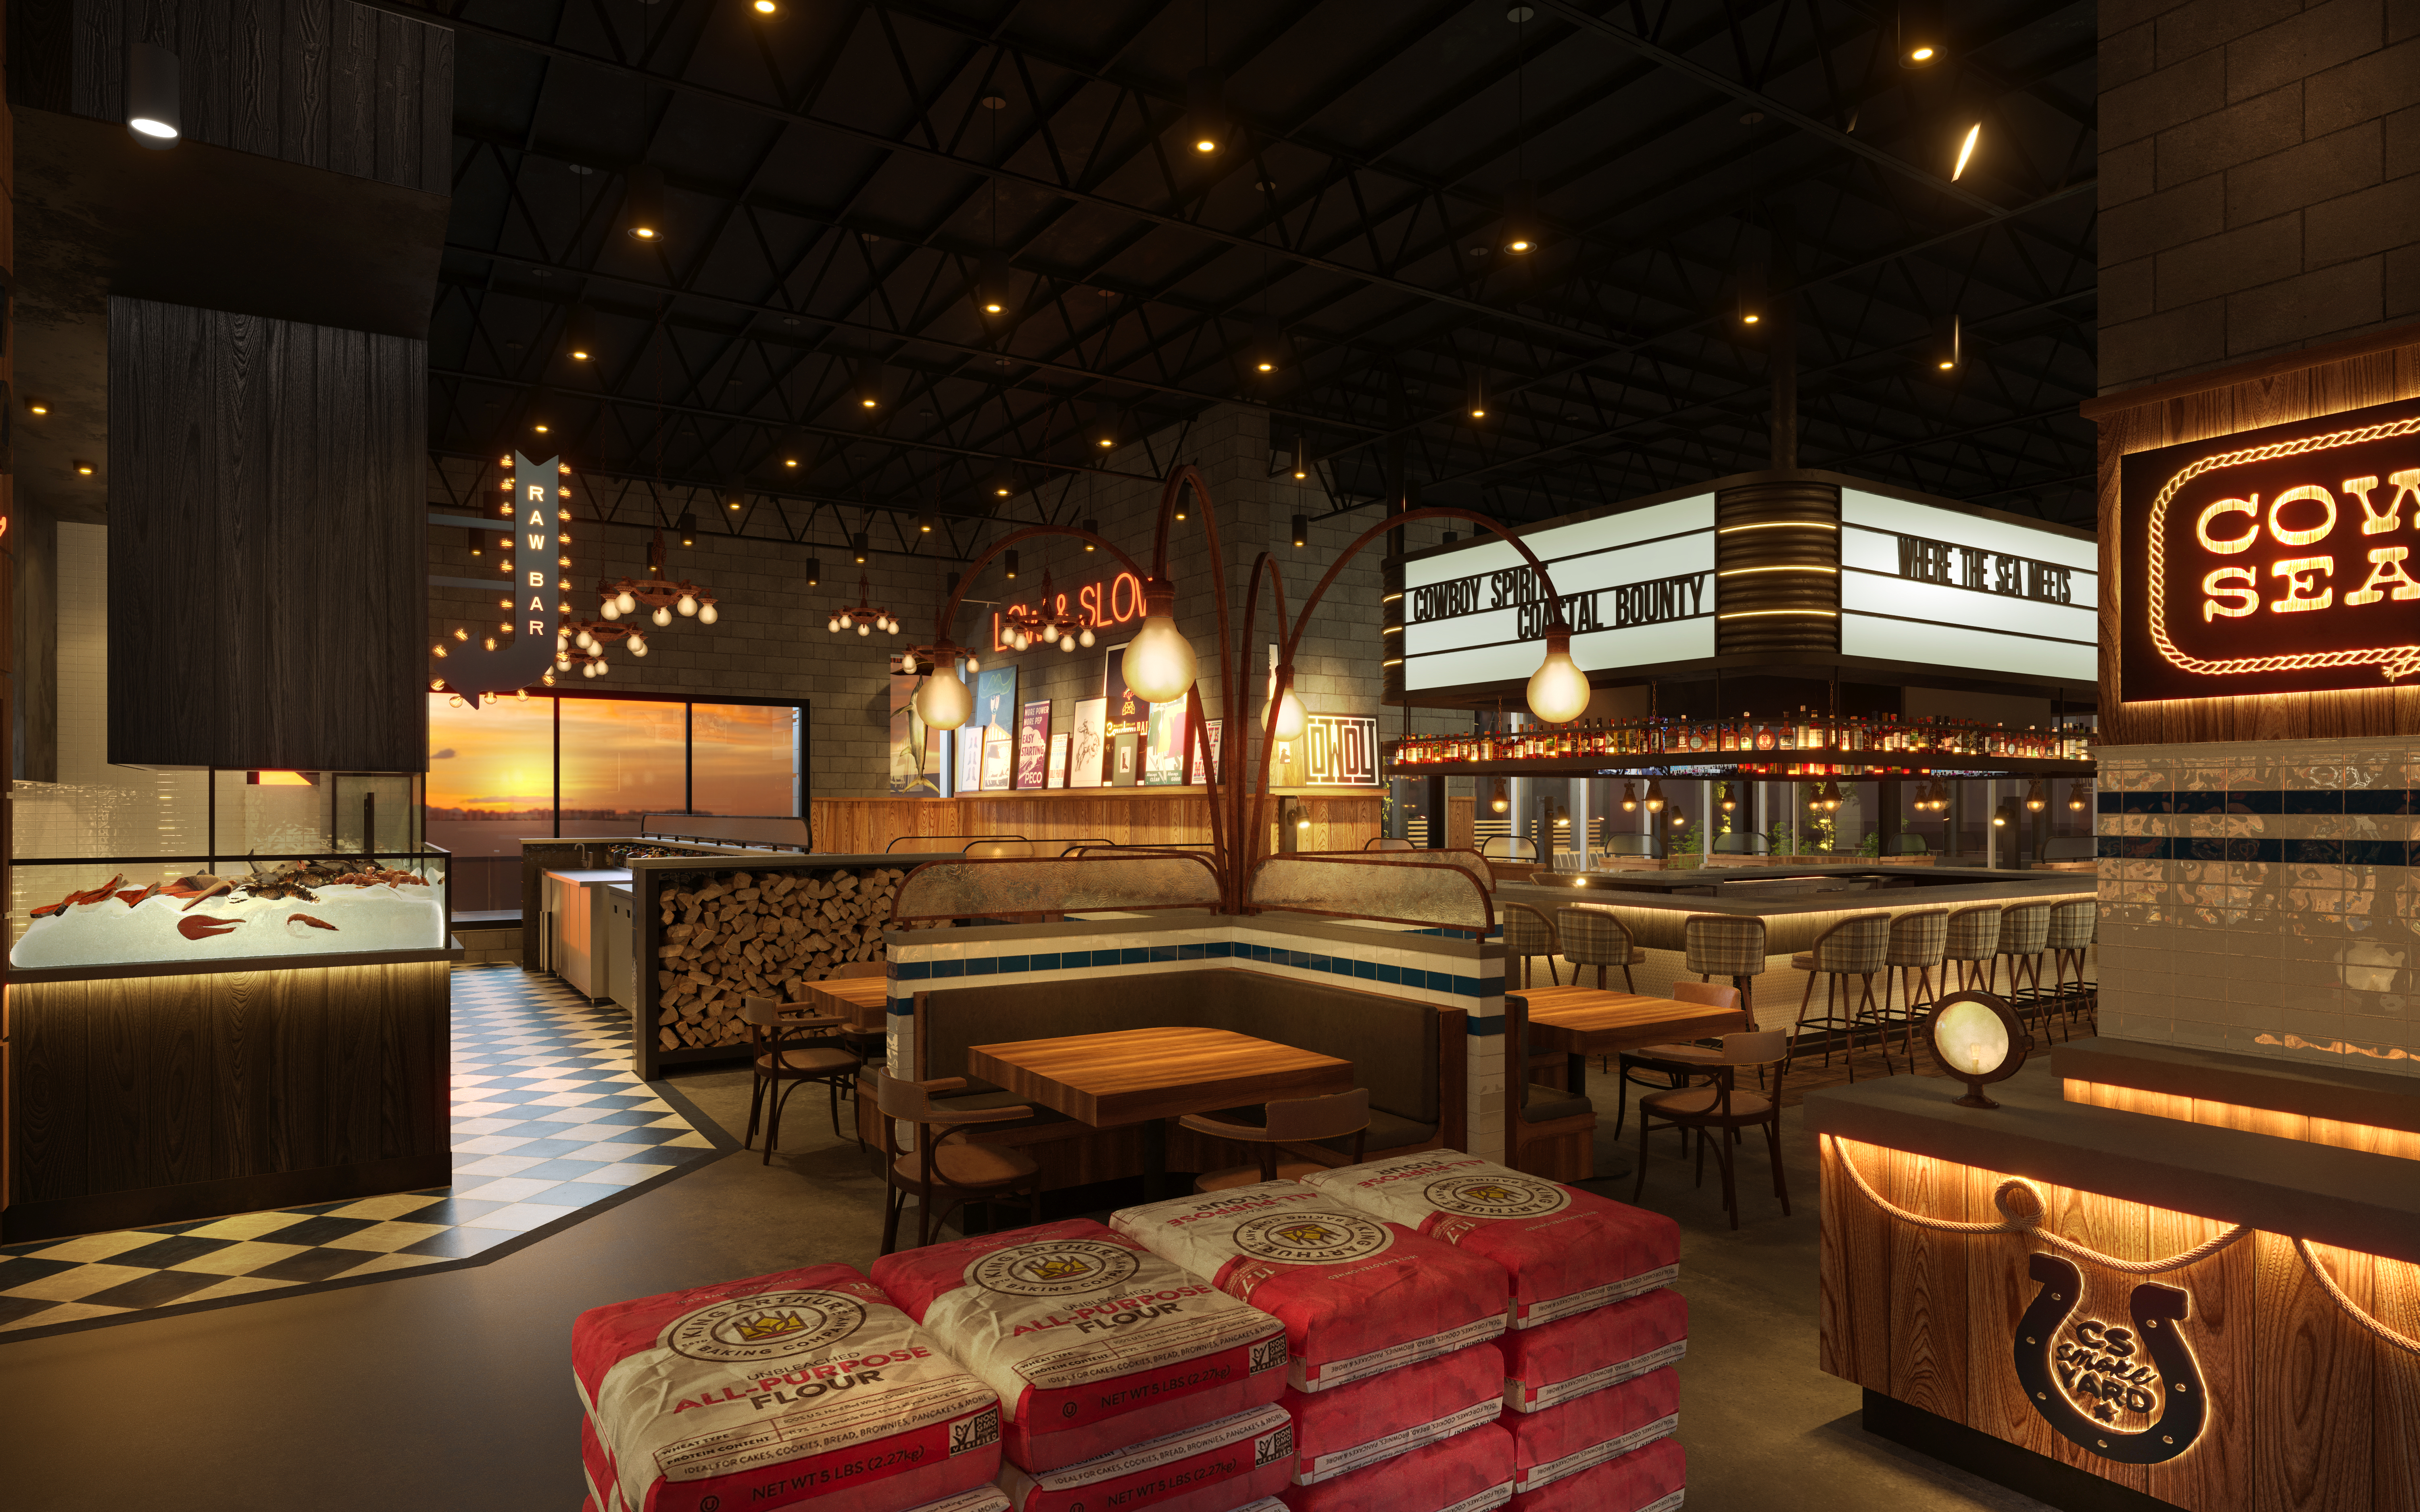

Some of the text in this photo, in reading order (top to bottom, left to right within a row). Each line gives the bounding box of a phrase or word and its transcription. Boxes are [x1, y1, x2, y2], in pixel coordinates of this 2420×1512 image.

[2197, 469, 2420, 554] COW
[529, 485, 544, 636] RAW BAR
[1897, 537, 2071, 603] WHERE THE SEA MEETS
[1414, 577, 1482, 621] COWBOY
[2202, 547, 2420, 623] SEA
[1616, 575, 1705, 625] BOUNTY
[1024, 706, 1049, 716] MORE POWER
[1021, 745, 1045, 756] STARTING
[1022, 733, 1035, 744] EASY
[1305, 717, 1376, 783] OWDY
[1024, 771, 1042, 784] PECO
[1056, 769, 1064, 778] PARTON
[1357, 1160, 1485, 1188] ALL-PURPOSE
[1374, 1160, 1444, 1175] FLOUR
[1404, 1168, 1462, 1181] UNBLEACHED
[1192, 1193, 1273, 1211] FLOUR
[1435, 1181, 1462, 1200] COMPANY
[1456, 1187, 1554, 1213] KING ARTHUR
[1166, 1193, 1318, 1227] ALL-PURPOSE
[1218, 1204, 1288, 1219] UNBLEACHED
[1245, 1218, 1281, 1241] COMPANY
[1262, 1226, 1376, 1258] KING ARTHUR
[985, 1244, 1114, 1279] KING ARTHUR
[1006, 1260, 1127, 1291] BAKING COMPANY
[1328, 1258, 1399, 1280] EMPLOYEE-OWNED
[704, 1278, 802, 1299] EMPLOYEE-OWNED
[1062, 1288, 1152, 1311] UNBLEACHED
[682, 1310, 727, 1339] KING
[735, 1296, 845, 1313] ARTHUR
[1014, 1284, 1213, 1337] ALL-PURPOSE
[1075, 1302, 1184, 1334] FLOUR
[697, 1317, 851, 1356] BAKING COMPANY
[1461, 1324, 1477, 1335] CAKES,
[1477, 1322, 1488, 1330] FOR
[2076, 1319, 2136, 1358] CS
[1047, 1372, 1072, 1384] IDEAL
[1072, 1370, 1089, 1379] FOR
[1089, 1364, 1117, 1376] CAKES,
[1154, 1350, 1180, 1364] BREAD,
[1181, 1340, 1219, 1356] BROWNIES,
[1220, 1331, 1255, 1345] PANCAKES
[1260, 1322, 1278, 1332] MORE
[1385, 1343, 1414, 1356] BROWNIES,
[1416, 1336, 1435, 1347] BREAD,
[747, 1352, 860, 1381] UNBLEACHED
[1021, 1351, 1074, 1369] WHEAT TYPE
[1029, 1353, 1109, 1376] PROTEIN CONTENT
[1331, 1363, 1348, 1372] MORE
[1353, 1351, 1383, 1366] PANCAKES
[673, 1346, 932, 1414] ALL-PURPOSE
[749, 1370, 885, 1410] FLOUR
[1100, 1364, 1231, 1408] NET WT 5 LBS (2.27kg)
[2057, 1362, 2157, 1414] YARD
[661, 1433, 730, 1455] WHEAT TYPE
[684, 1462, 716, 1474] IDEAL
[716, 1458, 738, 1470] FOR
[739, 1451, 774, 1465] CAKES,
[776, 1439, 823, 1456] COOKIES,
[823, 1432, 859, 1446] BREAD,
[860, 1419, 910, 1437] BROWNIES,
[912, 1404, 958, 1423] PANCAKES
[964, 1394, 988, 1406] MORE
[1054, 1412, 1284, 1485] IDEAL FOR CAKES, COOKIES, BREAD, BROWNIES, PANCAKES MORE
[667, 1436, 770, 1465] PROTEIN CONTENT
[751, 1443, 926, 1502] NET WT 5 LBS (2.27kg)
[1108, 1458, 1237, 1508] NET WT 5 LBS (2.27kg)
